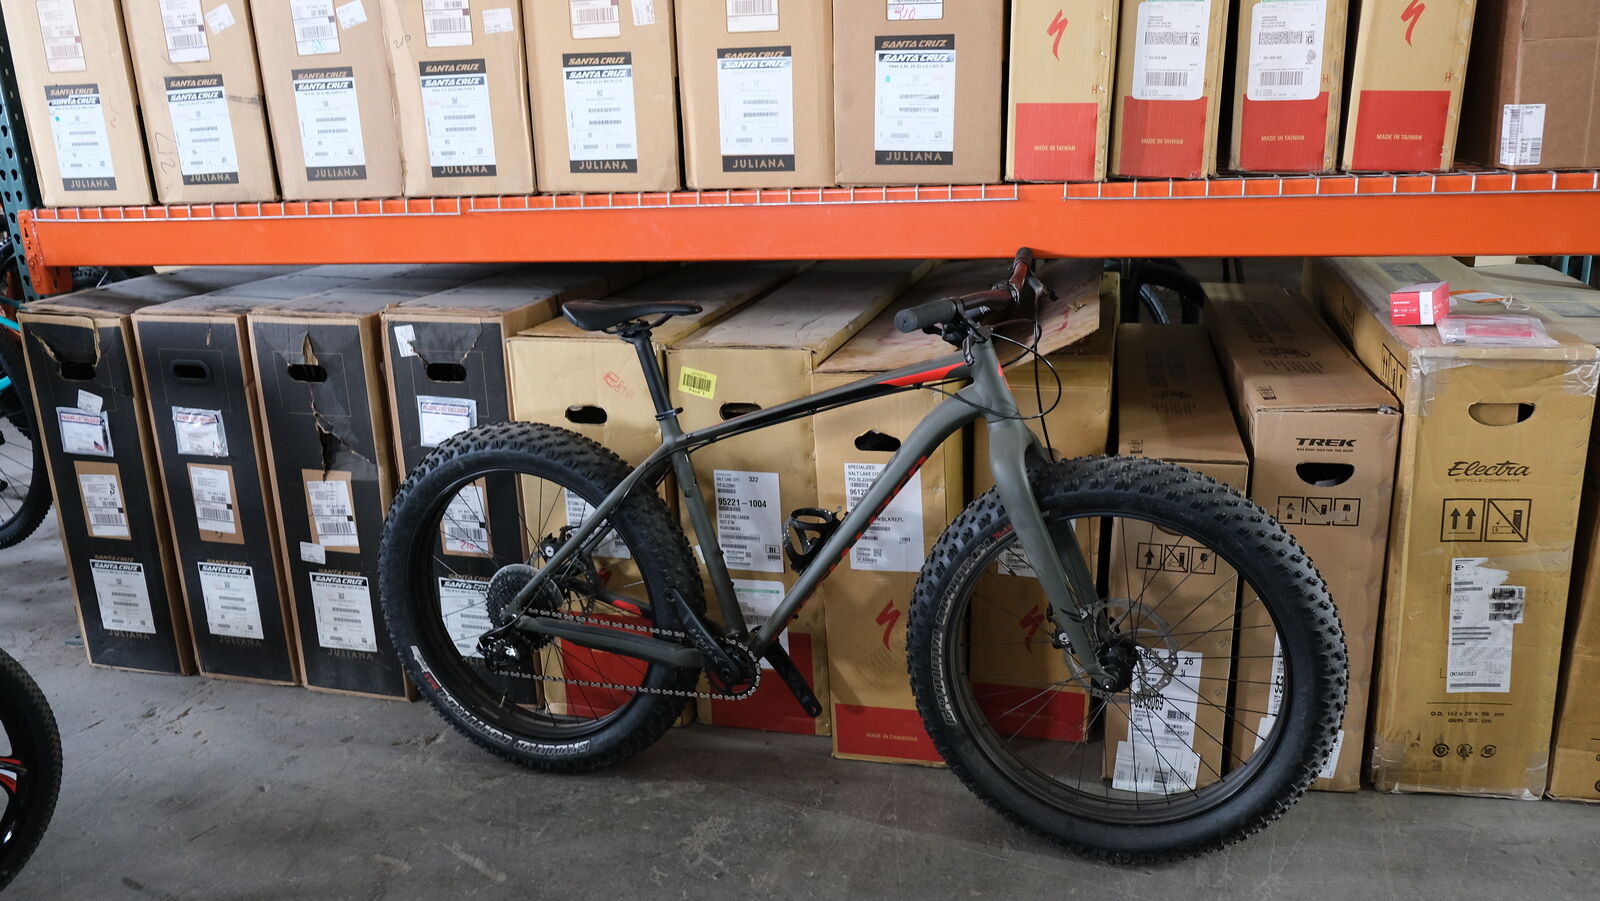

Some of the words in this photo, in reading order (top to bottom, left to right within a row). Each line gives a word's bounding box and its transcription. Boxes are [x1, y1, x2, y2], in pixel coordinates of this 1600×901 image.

[918, 39, 947, 47] CRUZ
[920, 54, 949, 62] CRUZ
[886, 152, 942, 161] JULIANA
[579, 161, 628, 170] JULIANA
[733, 159, 784, 168] JULIANA
[315, 168, 358, 178] JULIANA
[441, 165, 488, 174] JULIANA
[190, 174, 231, 182] JULIANA
[70, 180, 109, 188] JULIANA
[1296, 438, 1357, 447] TREK
[1448, 461, 1533, 476] Electra
[718, 498, 740, 506] 95221
[750, 500, 767, 508] 1004
[444, 581, 472, 590] SANTA
[936, 538, 996, 625] CONTROL
[1184, 657, 1194, 665] 26
[930, 628, 957, 725] GROUND
[437, 691, 513, 744] CONTROL
[514, 740, 591, 755] GROUND
